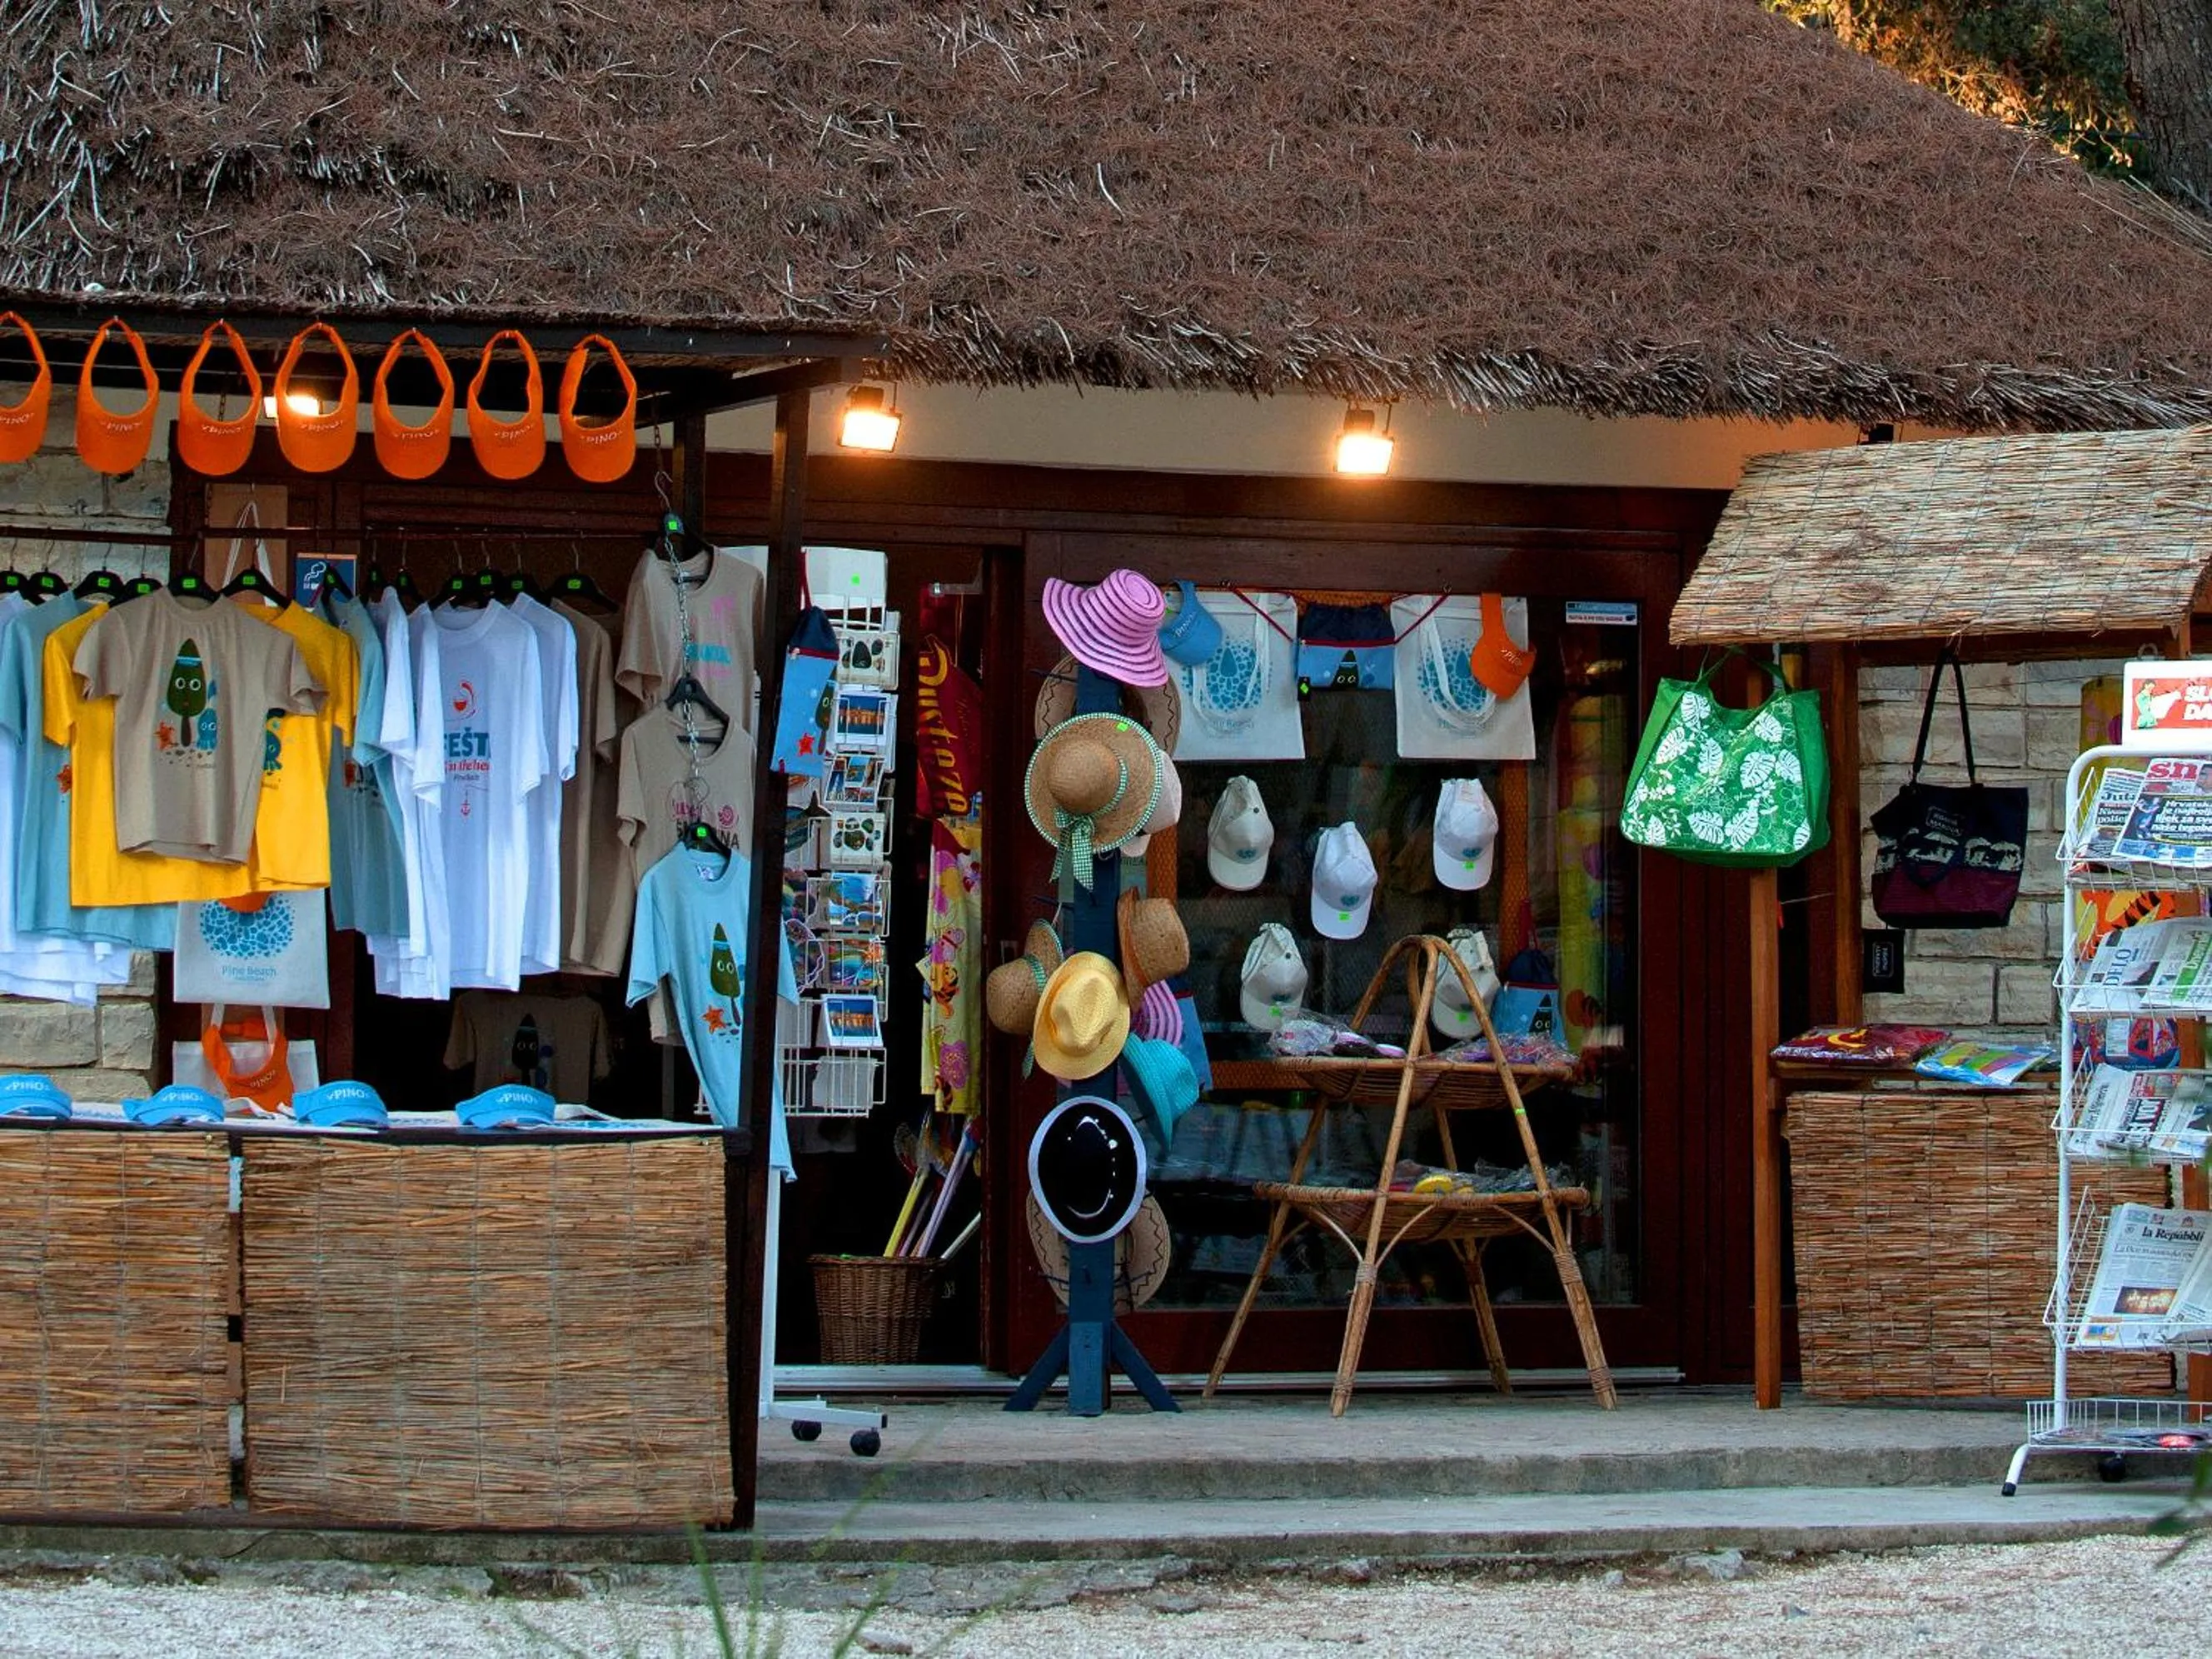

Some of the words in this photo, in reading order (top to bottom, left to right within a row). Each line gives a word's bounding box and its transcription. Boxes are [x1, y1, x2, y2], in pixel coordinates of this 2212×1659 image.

[444, 726, 491, 758] EŠT
[2147, 761, 2199, 780] sn
[12, 1081, 43, 1091] PINO
[333, 1088, 366, 1099] PINO
[504, 1092, 533, 1104] PINO
[2155, 1228, 2206, 1242] Repubbli
